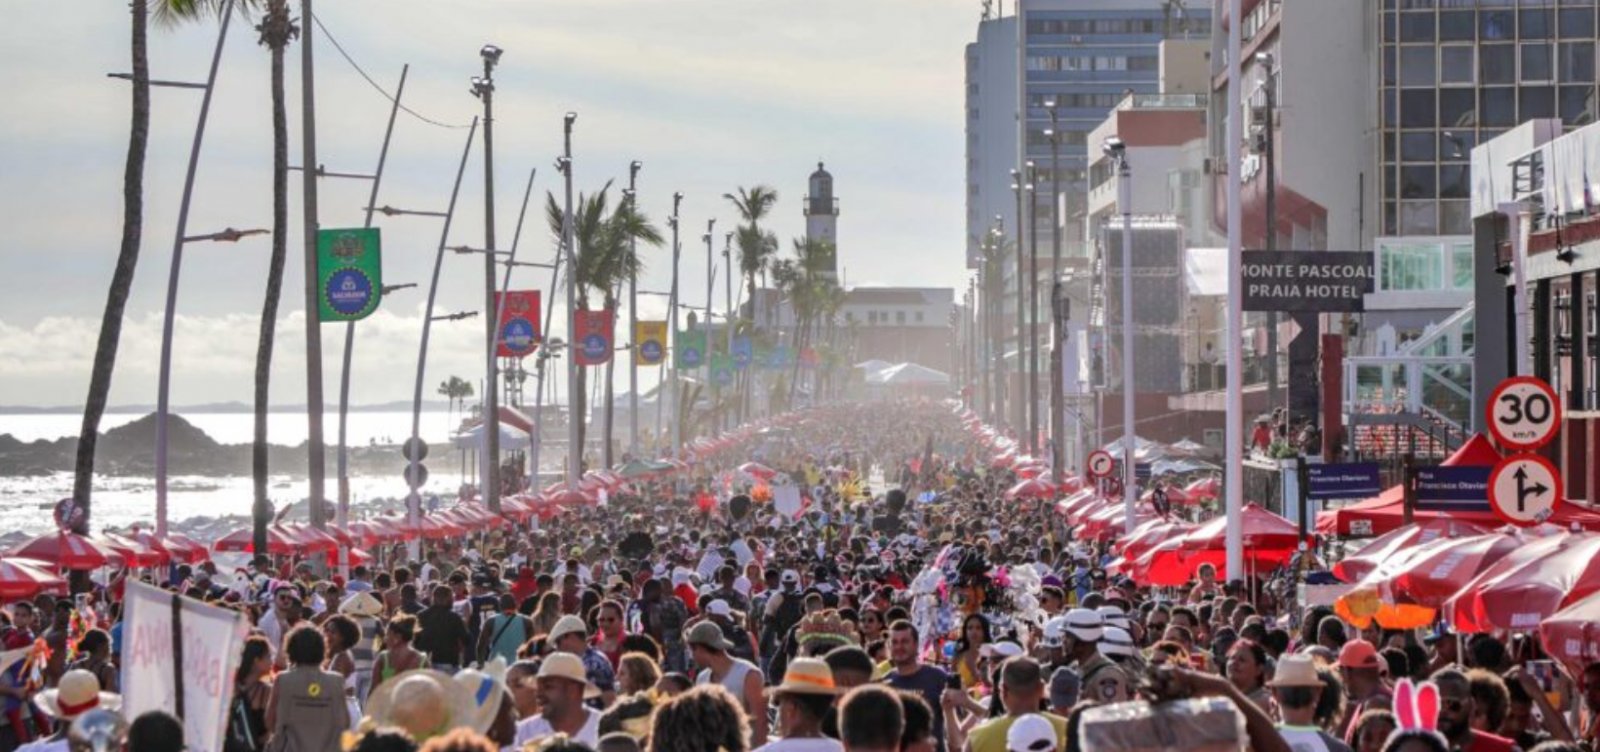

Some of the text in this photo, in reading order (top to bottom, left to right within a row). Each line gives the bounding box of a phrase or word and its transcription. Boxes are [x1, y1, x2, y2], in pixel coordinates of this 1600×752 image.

[1299, 265, 1375, 278] PASCOAL
[1249, 284, 1360, 298] PRAIA HOTEL
[1499, 393, 1551, 425] 30
[1512, 431, 1537, 439] km/h
[1418, 481, 1488, 490] Francisco Otavian
